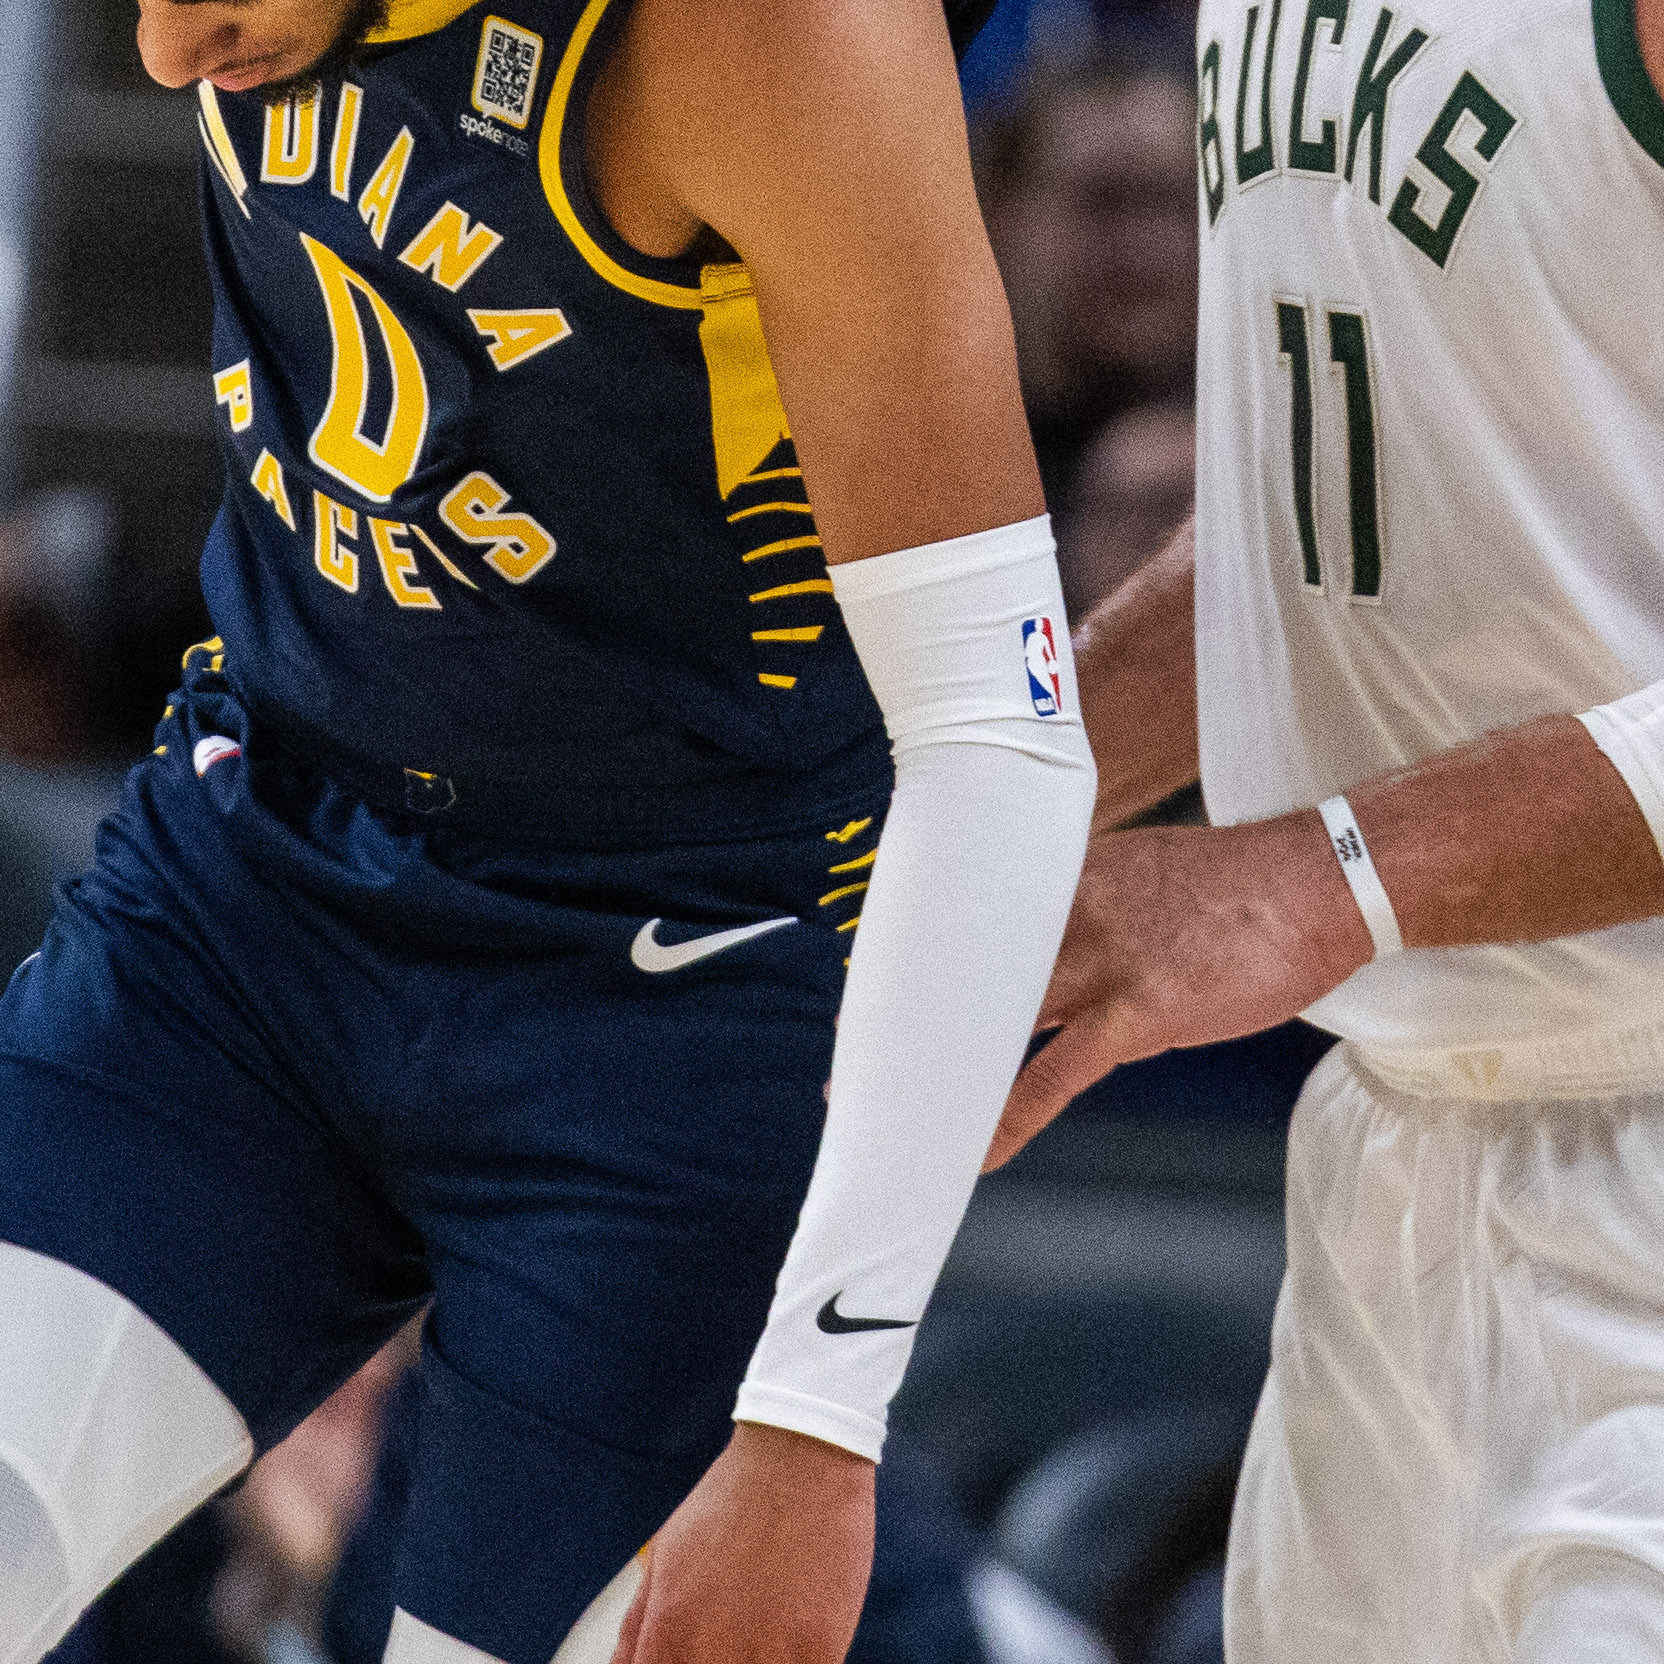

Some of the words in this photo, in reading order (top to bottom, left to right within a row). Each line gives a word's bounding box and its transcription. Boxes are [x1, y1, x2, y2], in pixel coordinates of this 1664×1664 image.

[198, 77, 573, 372] DIANA
[212, 358, 558, 611] PACES
[300, 231, 429, 503] 0
[1274, 295, 1383, 604] 11
